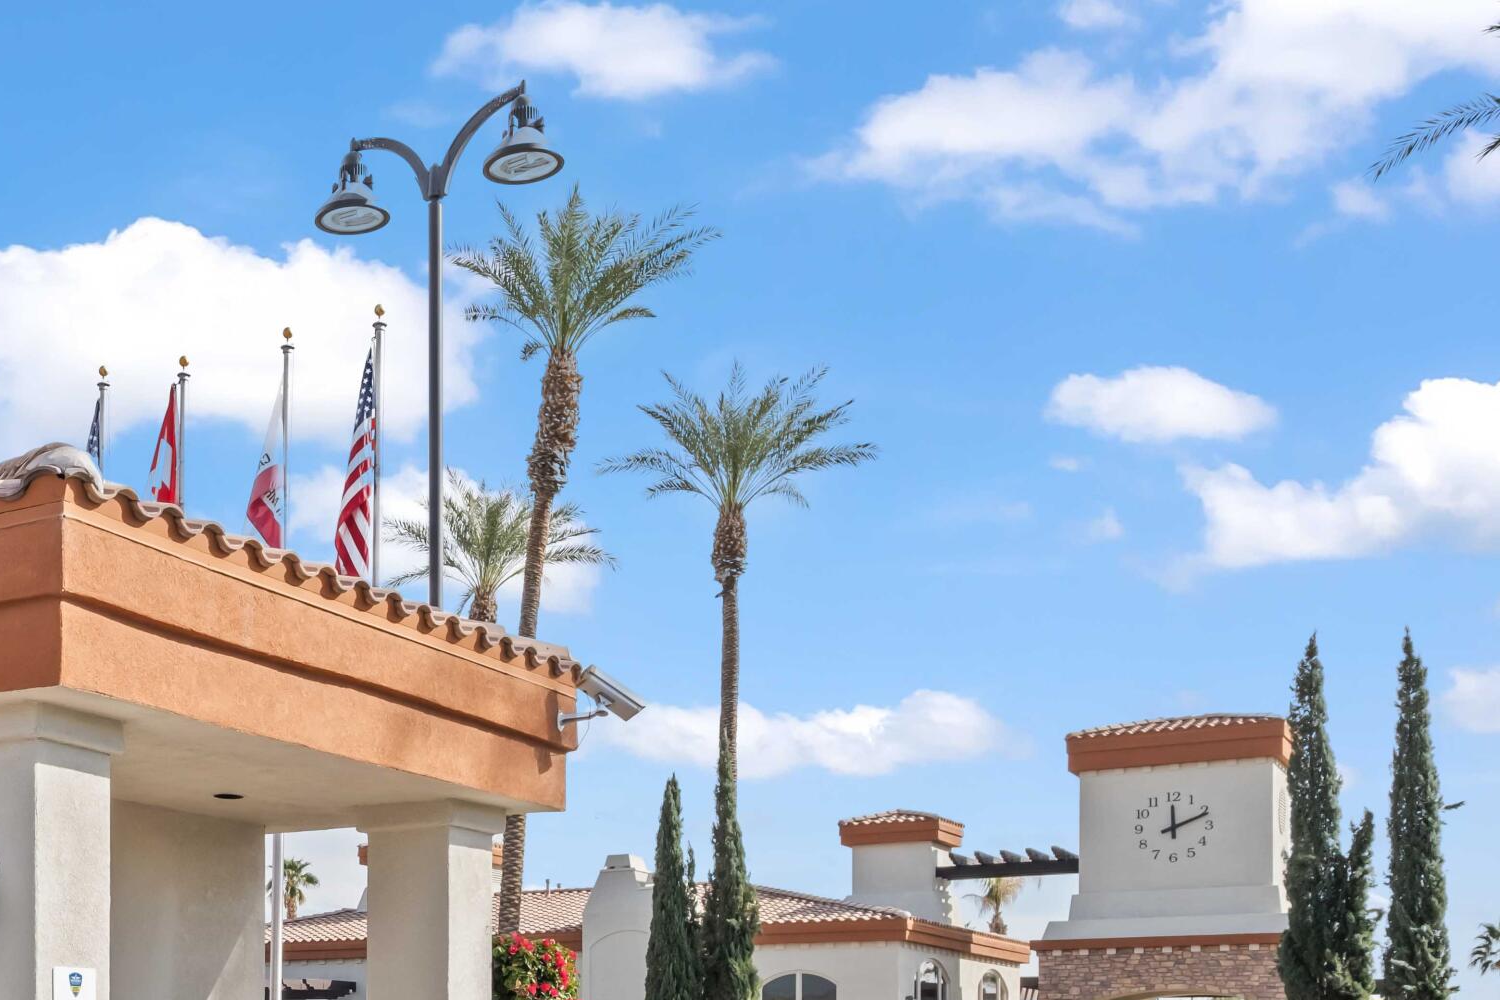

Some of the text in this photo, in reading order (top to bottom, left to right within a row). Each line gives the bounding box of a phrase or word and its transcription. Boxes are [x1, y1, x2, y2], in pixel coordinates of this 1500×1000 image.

[1166, 791, 1181, 802] 12
[1189, 794, 1193, 805] 1
[1148, 797, 1158, 807] 11
[1136, 808, 1150, 819] 10
[1200, 805, 1209, 815] 2
[1134, 824, 1143, 834] 9
[1204, 820, 1214, 830] 3
[1139, 839, 1148, 849] 8
[1198, 835, 1206, 846] 4
[1152, 849, 1161, 860] 7
[1187, 847, 1196, 858] 5
[1169, 853, 1178, 863] 6
